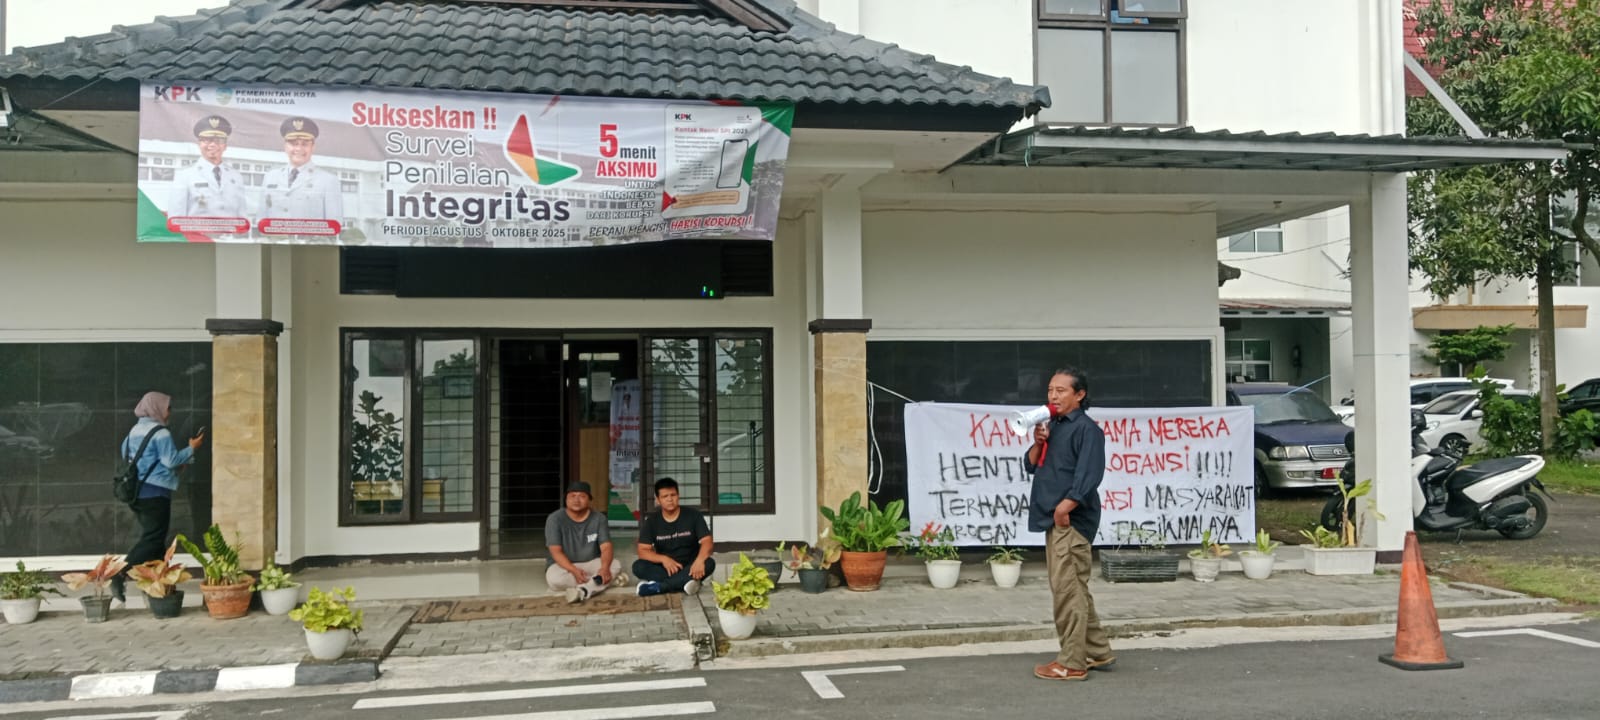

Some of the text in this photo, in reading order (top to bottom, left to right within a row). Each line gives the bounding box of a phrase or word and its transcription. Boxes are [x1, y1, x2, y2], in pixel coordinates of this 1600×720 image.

[154, 86, 202, 102] KPK
[236, 90, 291, 98] PEMERINTAH
[352, 102, 475, 129] Sukseskan
[386, 132, 474, 156] Survei
[599, 124, 656, 160] 5 menit
[386, 161, 510, 186] Penilaian
[596, 160, 657, 178] AKSIMU
[603, 191, 656, 200] INDONESIA
[624, 181, 657, 190] UNTUK
[386, 186, 570, 224] Integritas
[586, 210, 654, 220] DARI KORUPSI
[626, 200, 655, 209] BEBAS
[384, 226, 428, 236] PERIODE
[432, 226, 482, 237] AGUSTUS
[492, 228, 538, 238] OKTOBER
[542, 228, 566, 238] 2025
[589, 226, 628, 237] BERANI
[670, 216, 702, 230] HABISI
[704, 216, 746, 228] KORUPSI
[1096, 418, 1142, 448] AMA
[1149, 416, 1230, 445] MEREKA
[938, 452, 1031, 482] HENTI
[1104, 446, 1191, 475] OGANSI
[928, 484, 1254, 518] TERHADA ASI MASYARAKAT
[1112, 514, 1242, 542] TASIKMALAYA
